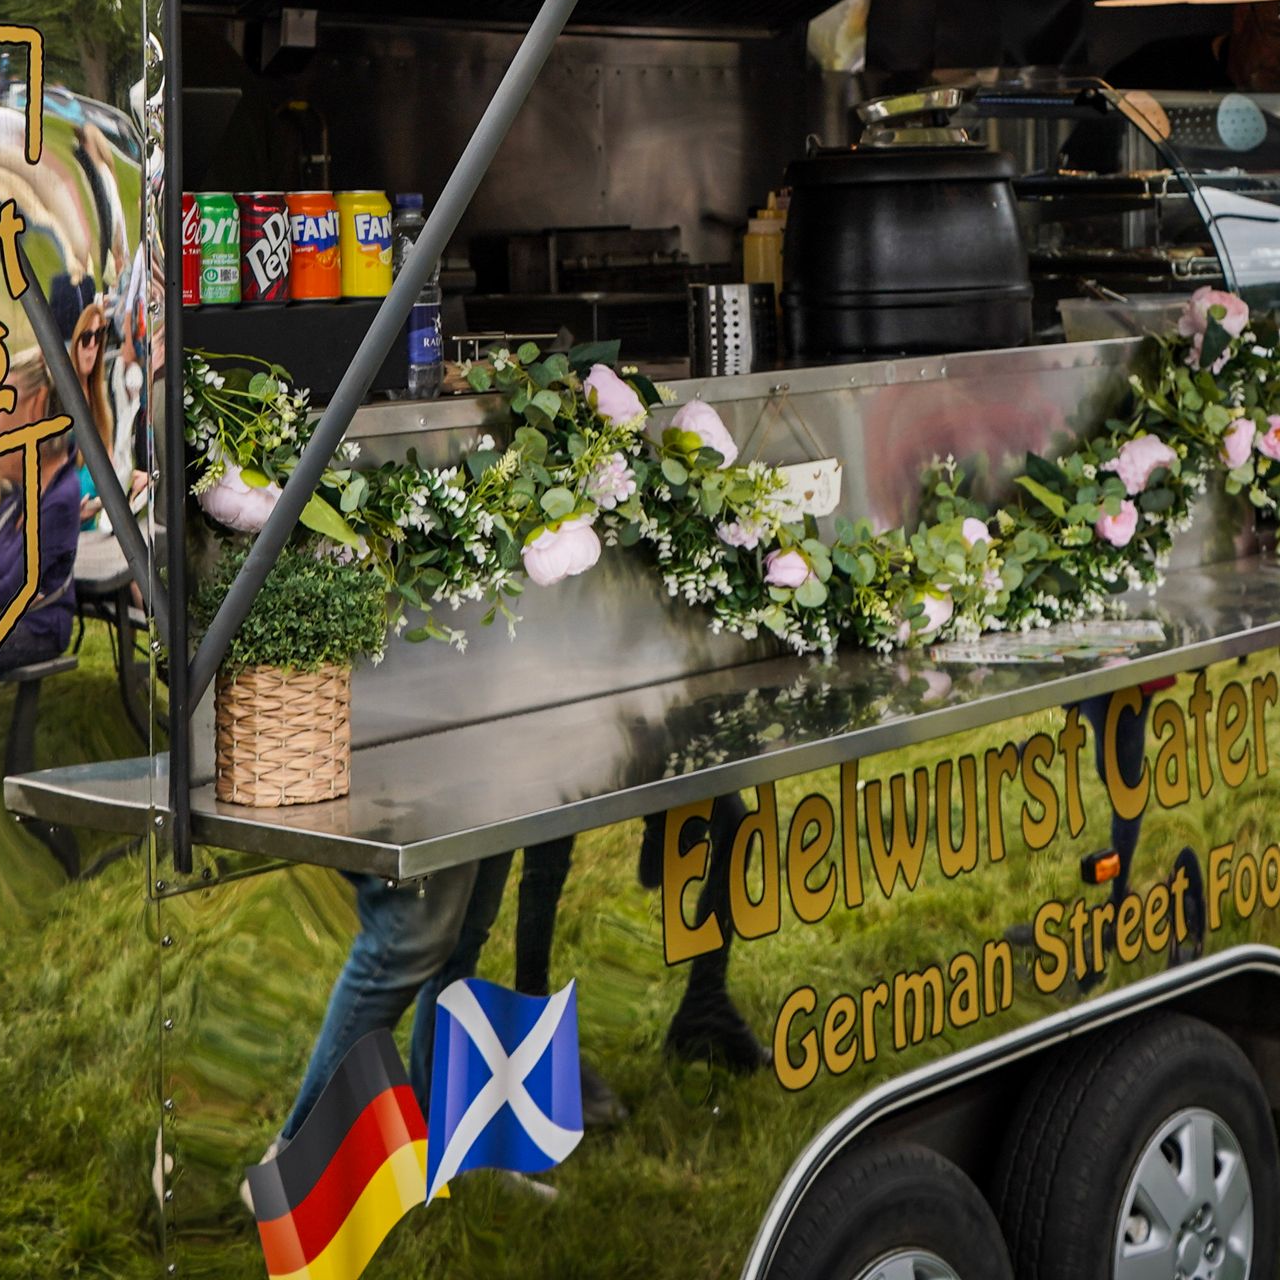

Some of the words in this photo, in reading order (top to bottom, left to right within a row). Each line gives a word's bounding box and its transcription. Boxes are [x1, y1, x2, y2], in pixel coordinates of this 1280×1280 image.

[246, 228, 292, 294] Pep
[661, 712, 1089, 967] Edelwurst
[772, 940, 1015, 1093] German
[1032, 865, 1195, 996] Street
